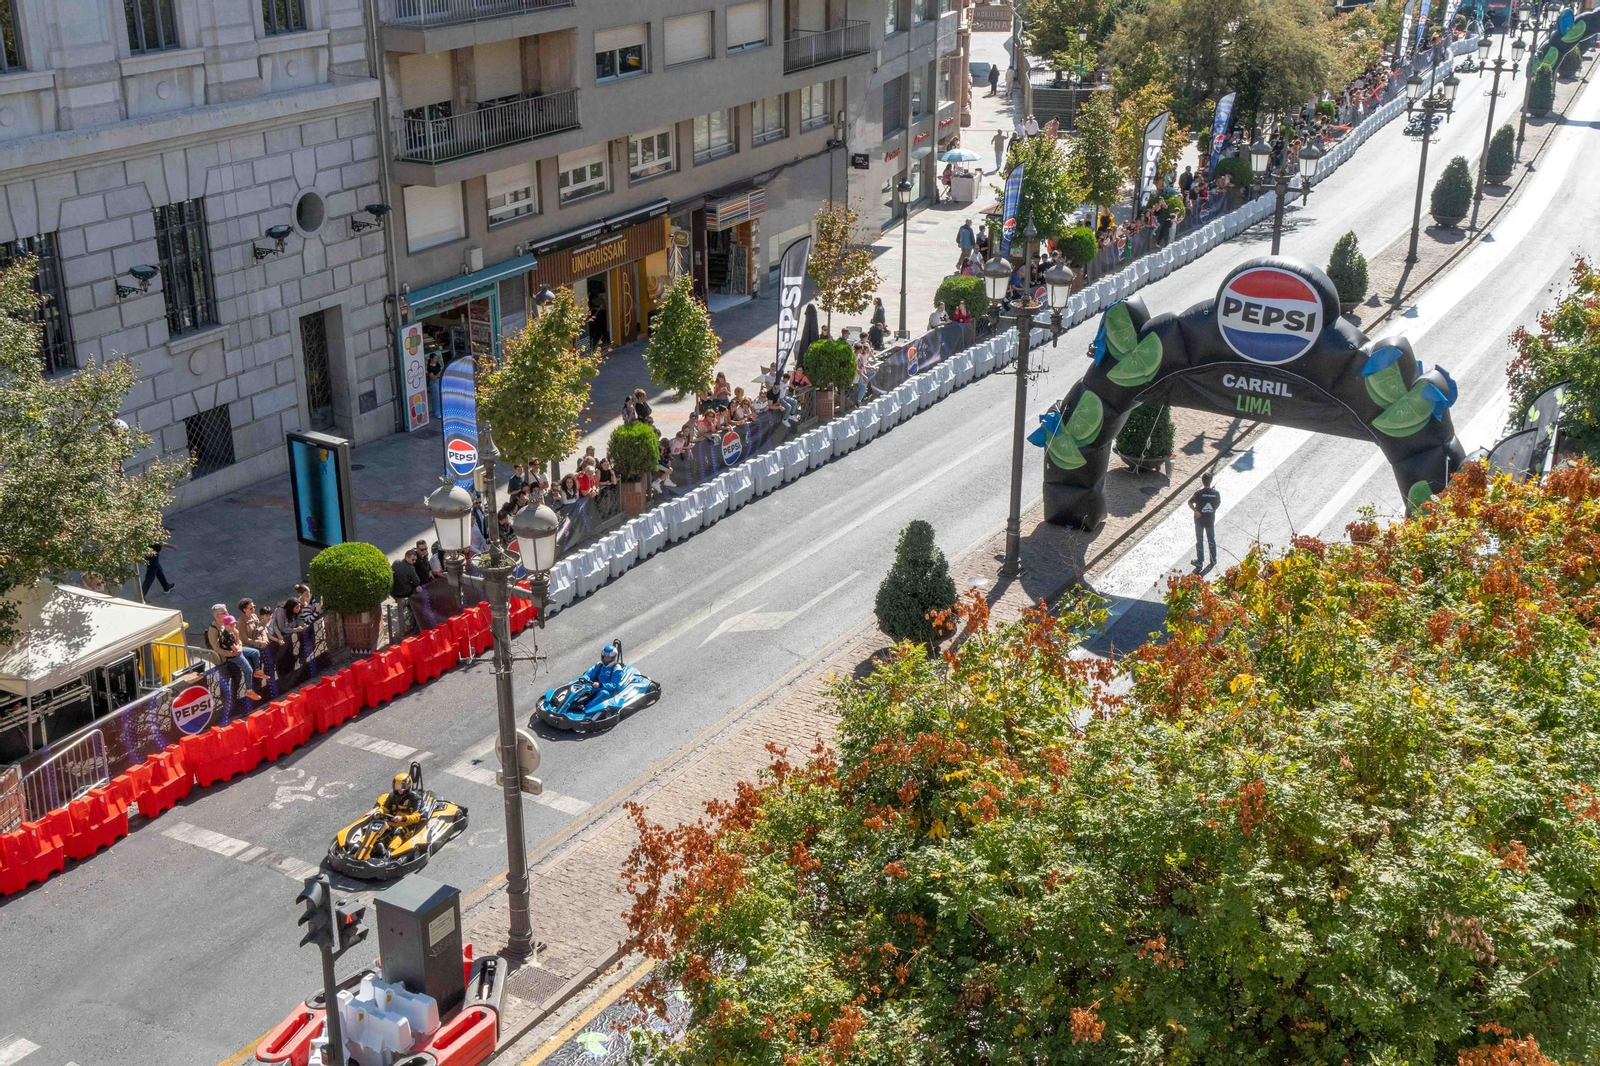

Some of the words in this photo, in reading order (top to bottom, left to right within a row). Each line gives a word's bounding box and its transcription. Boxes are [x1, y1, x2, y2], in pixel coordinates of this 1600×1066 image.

[571, 239, 628, 274] UNICROISSANT
[777, 276, 803, 371] PEPSI
[1222, 296, 1317, 333] PEPSI
[1222, 373, 1293, 398] CARRIL
[1236, 394, 1272, 417] LIMA
[449, 451, 476, 461] PEPSI
[723, 442, 742, 456] PEPSI
[174, 698, 212, 722] PEPSI
